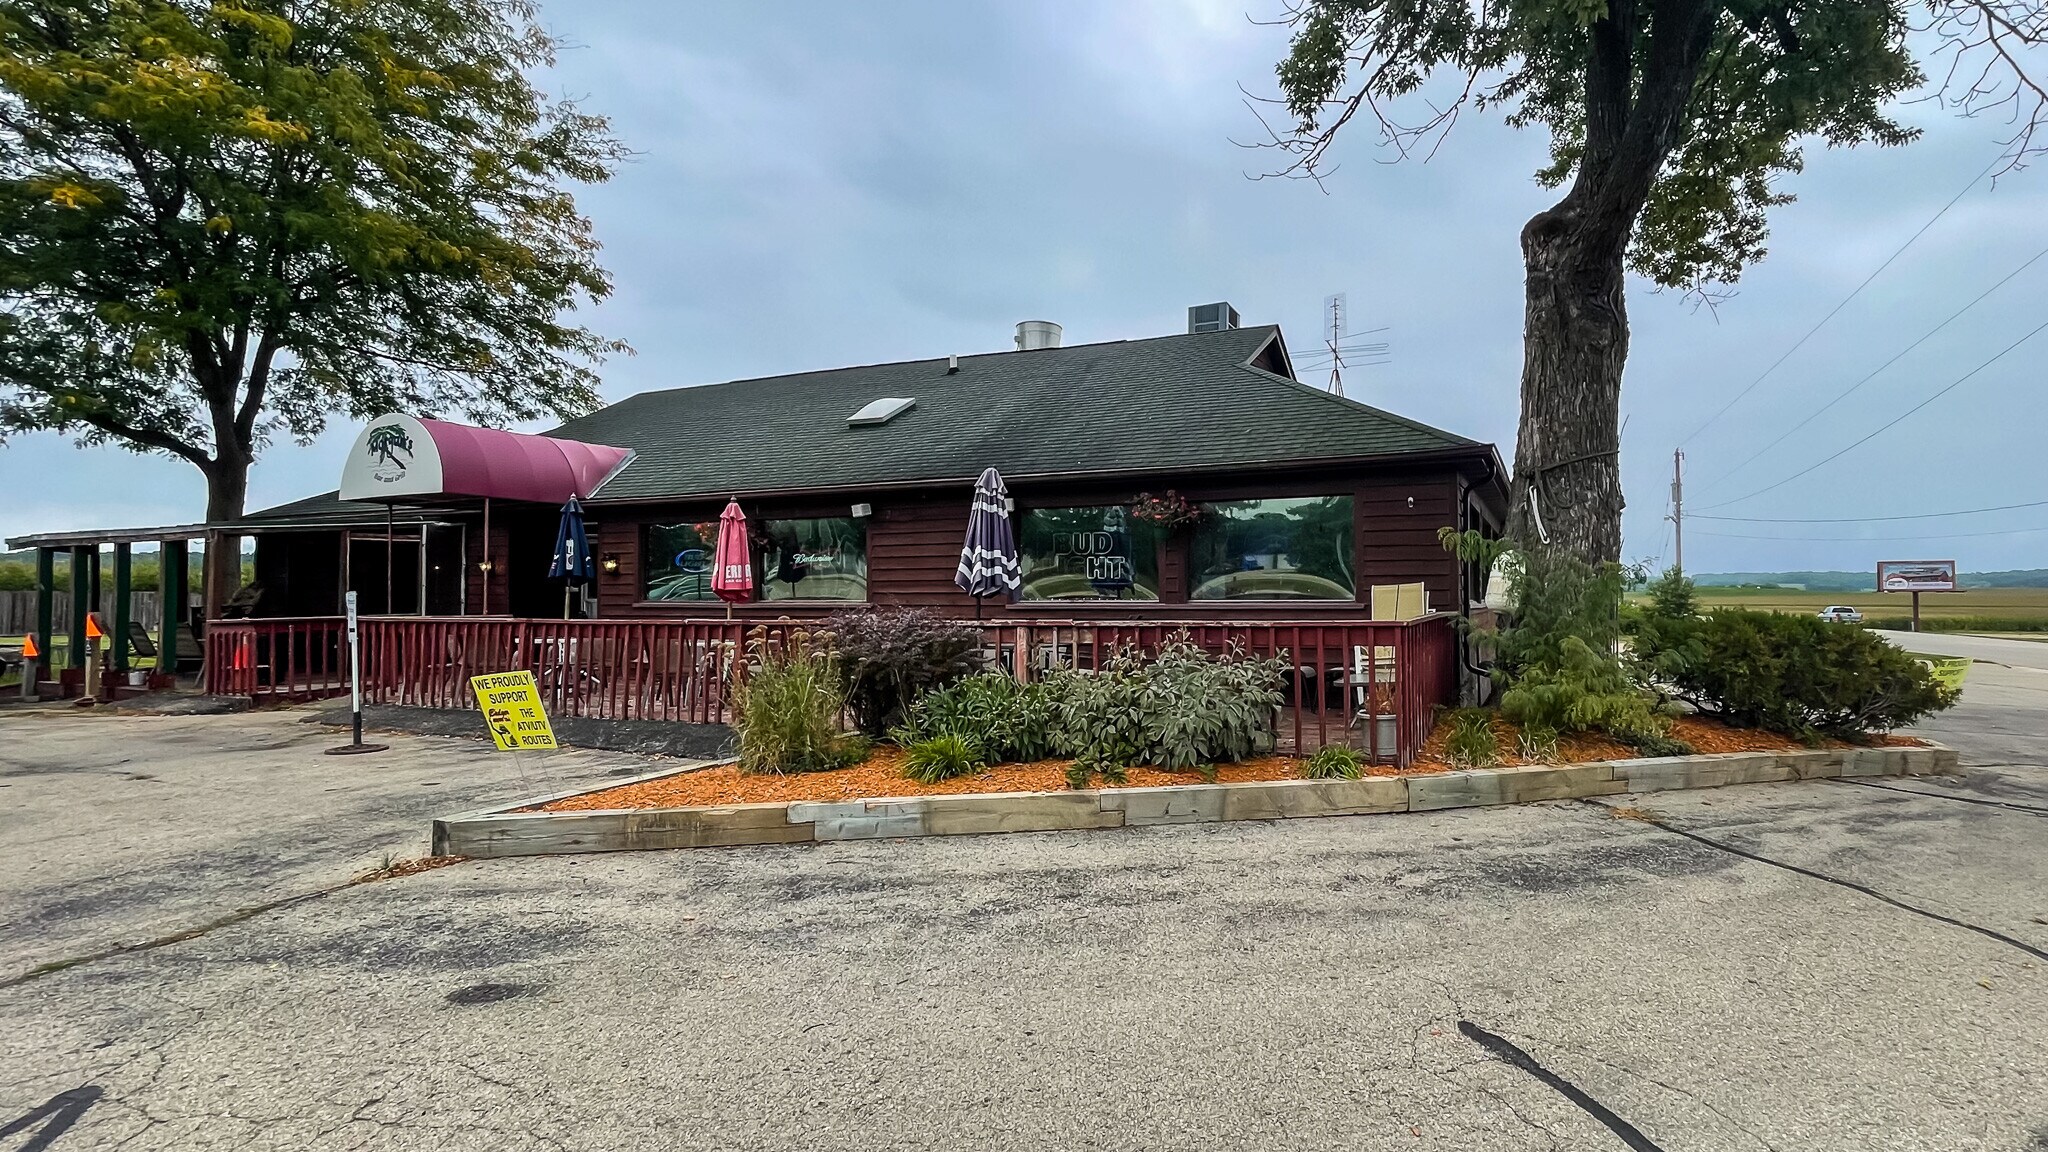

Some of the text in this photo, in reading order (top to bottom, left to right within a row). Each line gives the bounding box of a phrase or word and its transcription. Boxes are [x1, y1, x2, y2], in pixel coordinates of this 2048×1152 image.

[474, 674, 530, 690] WE PROUDLY
[489, 691, 529, 704] SUPPORT
[519, 708, 535, 718] THE
[517, 721, 546, 731] ATV/UTV
[522, 735, 552, 745] ROUTES
